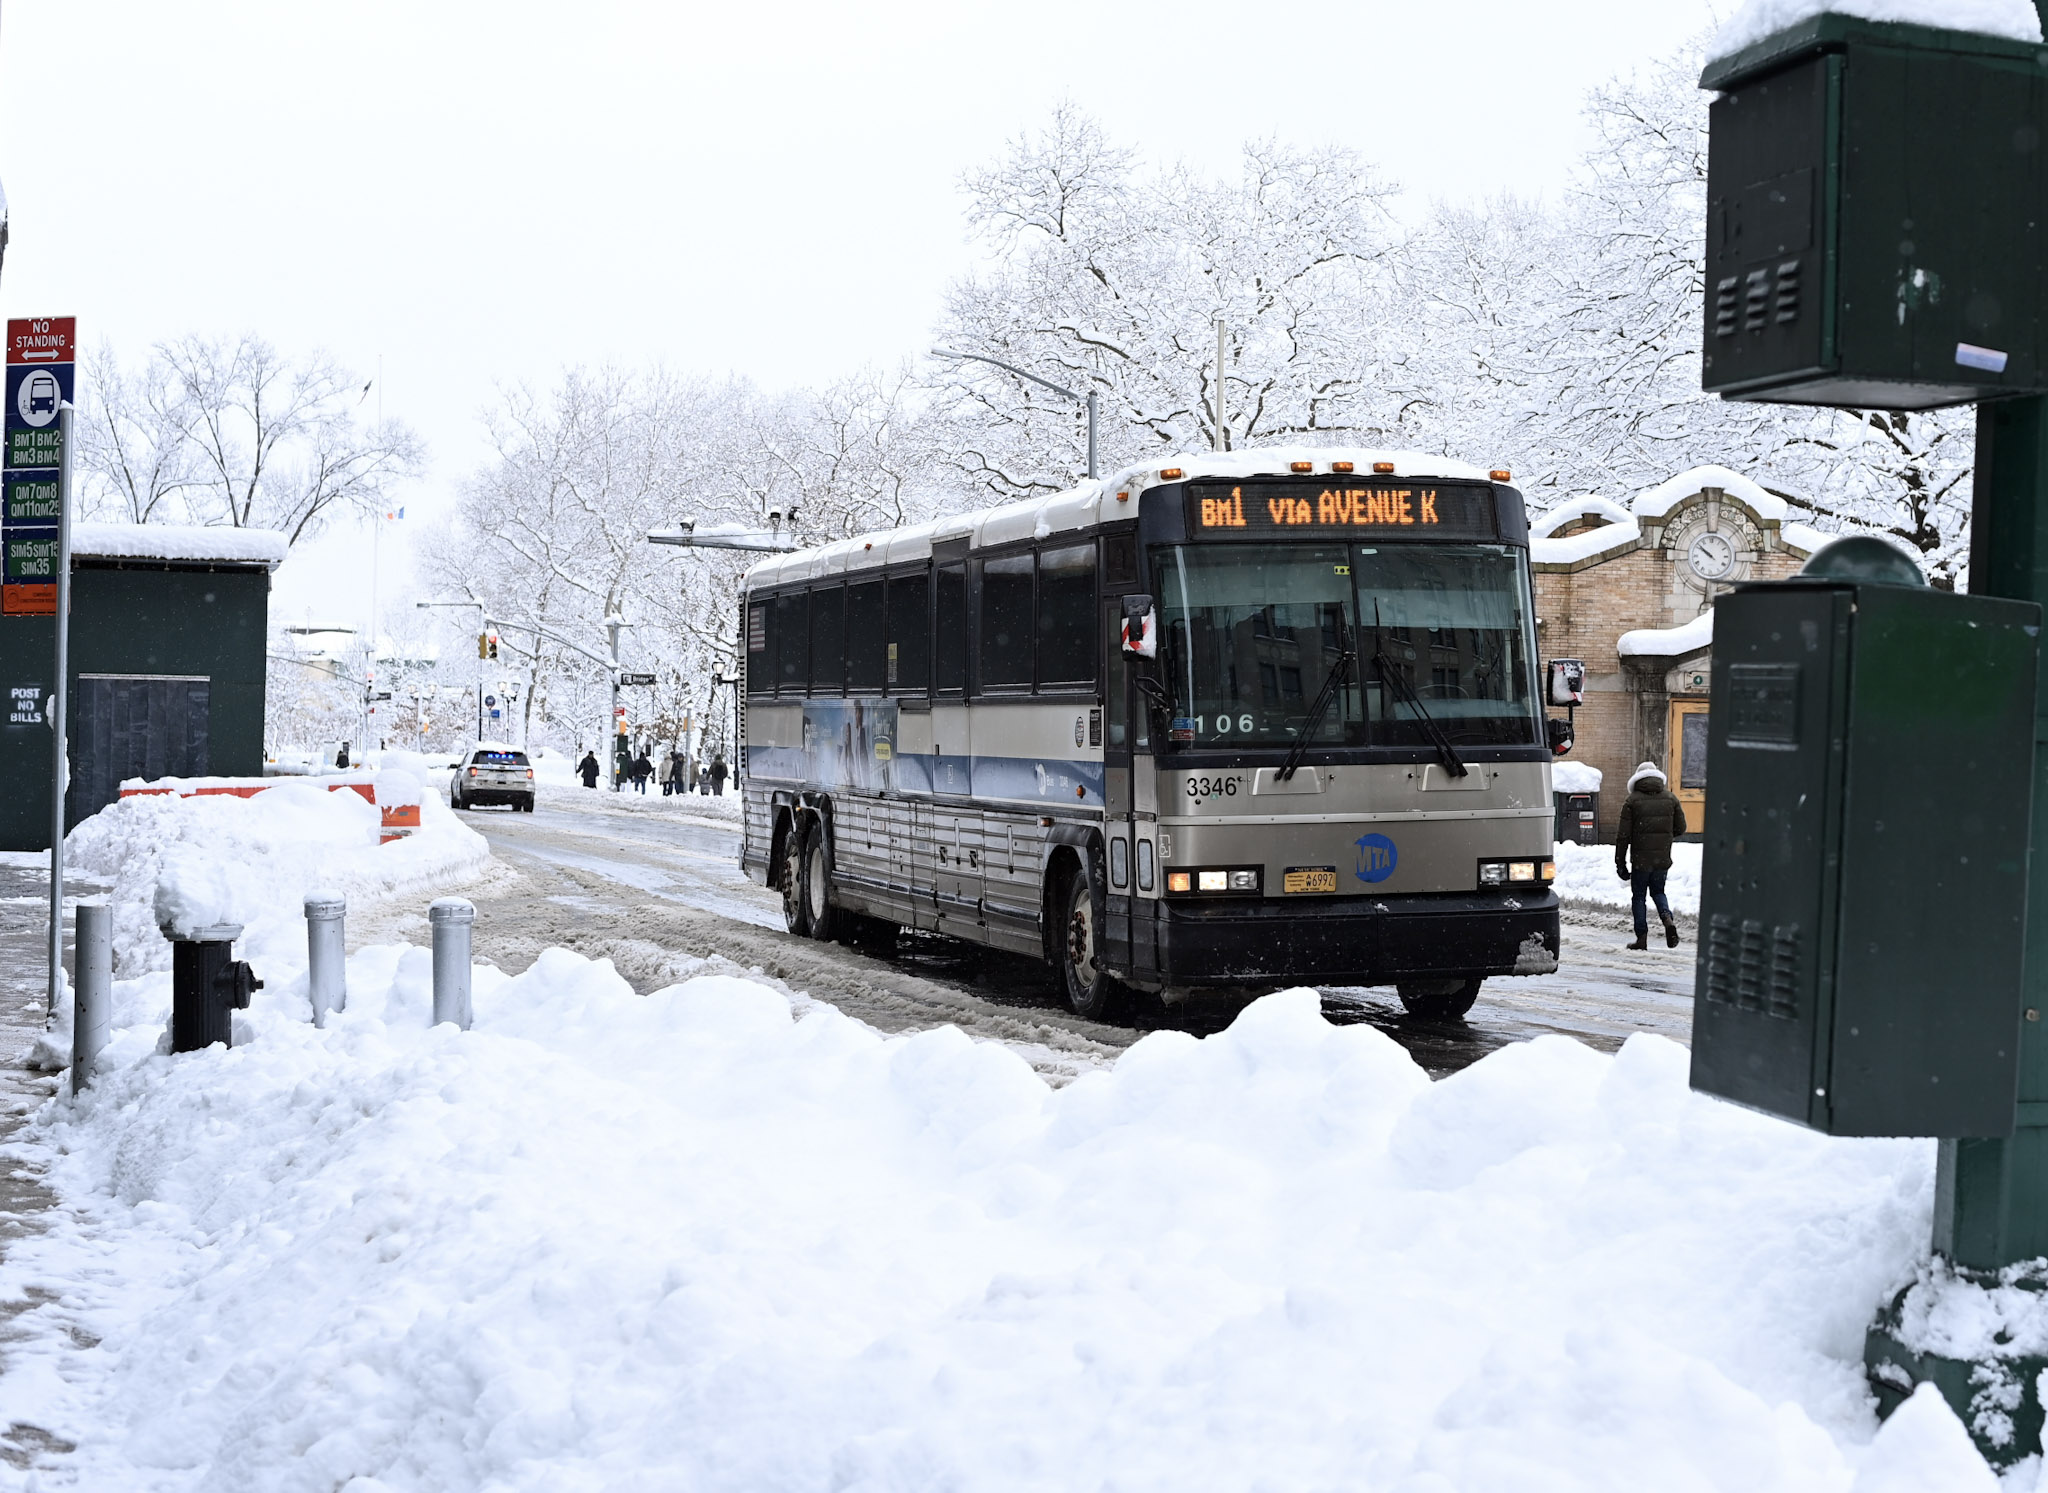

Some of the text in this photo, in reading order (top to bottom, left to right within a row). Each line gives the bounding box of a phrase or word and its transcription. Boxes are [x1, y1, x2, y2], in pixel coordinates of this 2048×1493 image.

[33, 321, 49, 334] NO
[16, 334, 65, 348] STANDING
[14, 430, 60, 447] BM1 BM2
[13, 447, 60, 464] BM3 BM4
[16, 482, 57, 500] QM7 QM8
[11, 501, 35, 517] QM11
[1201, 486, 1439, 527] BM1 VIA AVENUE K
[11, 541, 58, 558] SIM5 SIM15
[21, 557, 50, 575] SIM35
[11, 688, 40, 699] POST
[17, 700, 35, 711] NO
[10, 712, 42, 723] BILLS
[1186, 777, 1237, 797] 3346
